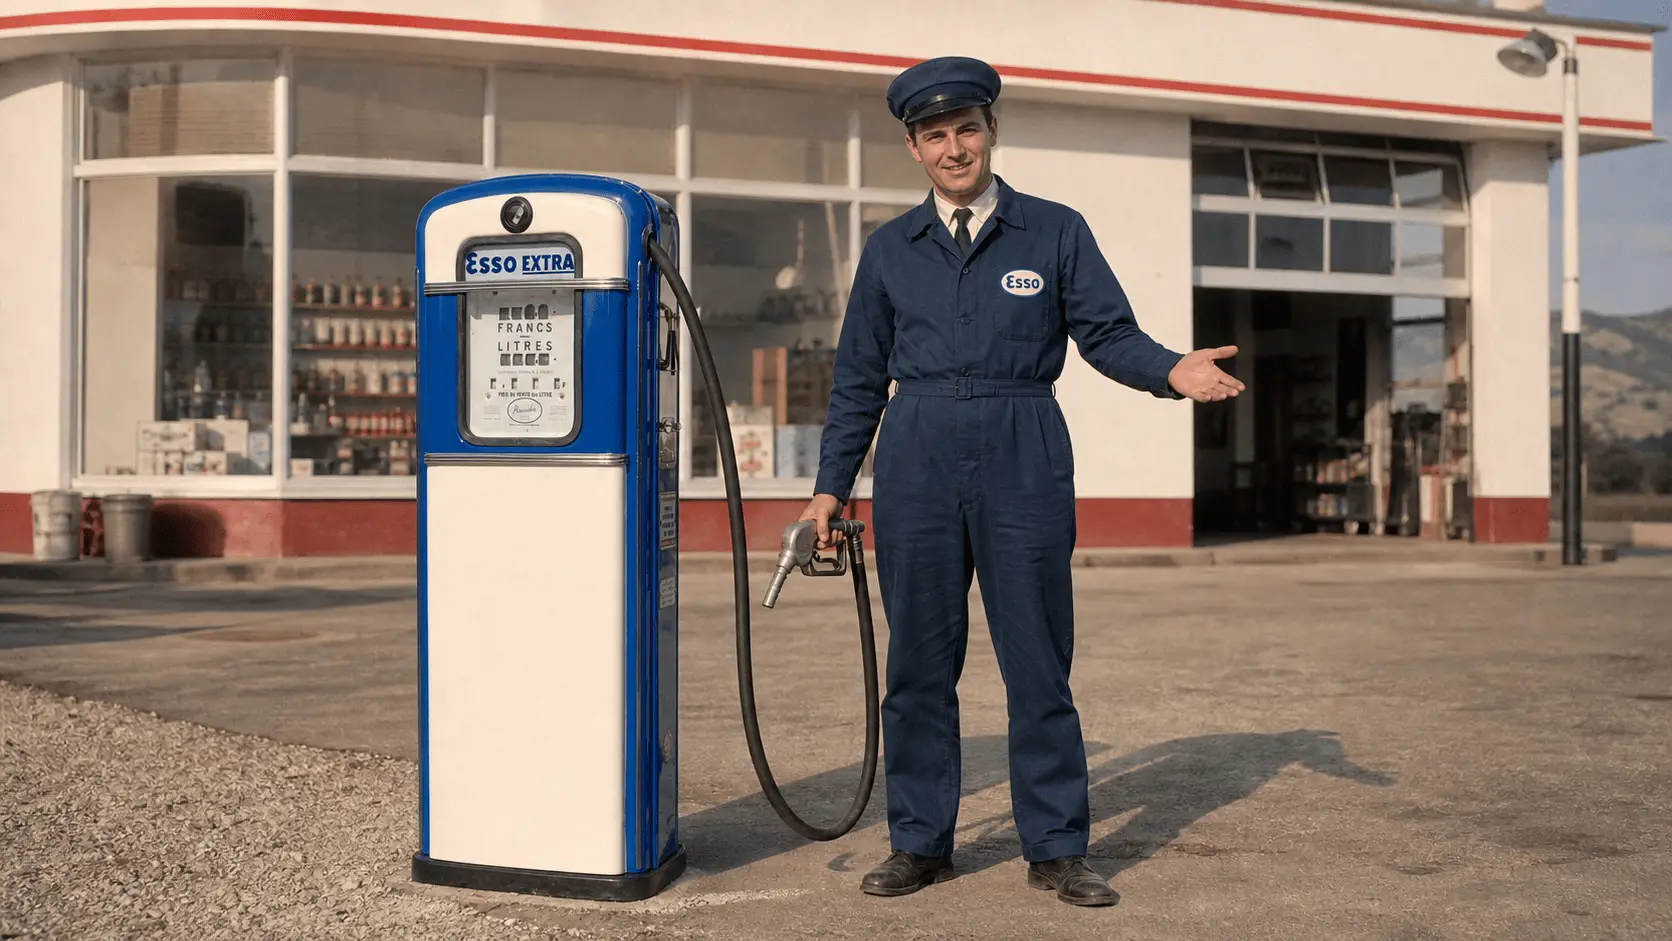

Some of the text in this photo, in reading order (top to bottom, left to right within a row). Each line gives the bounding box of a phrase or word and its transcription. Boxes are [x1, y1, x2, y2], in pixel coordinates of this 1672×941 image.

[522, 253, 575, 272] EXTRA
[497, 322, 553, 333] FRANCS
[497, 340, 553, 352] LITRES
